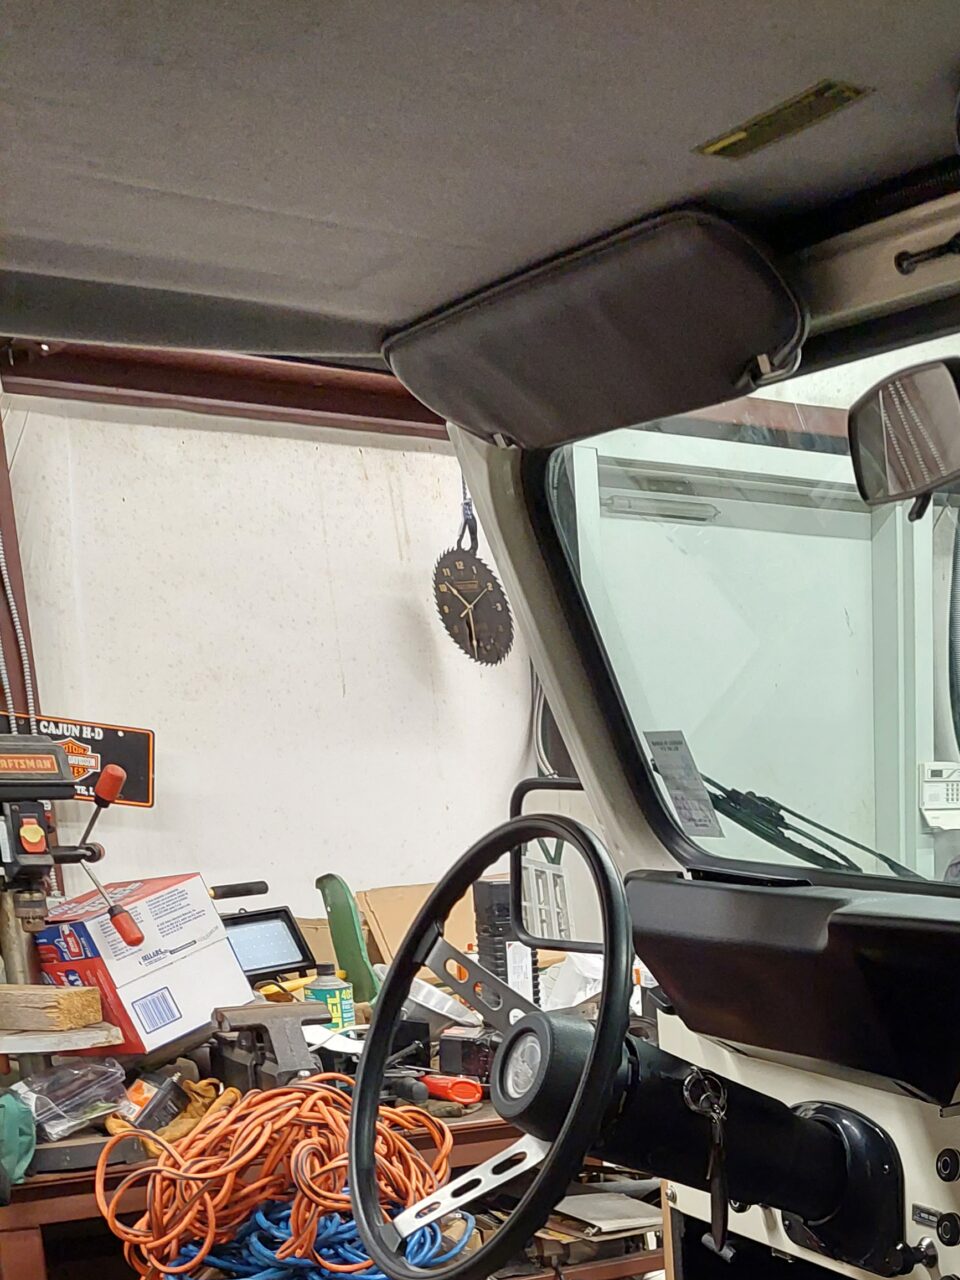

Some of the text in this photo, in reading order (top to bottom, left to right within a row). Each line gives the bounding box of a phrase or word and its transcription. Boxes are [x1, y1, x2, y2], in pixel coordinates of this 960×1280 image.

[455, 561, 464, 570] 12
[442, 567, 451, 577] 11
[40, 720, 104, 740] CAJUN H-D
[0, 758, 52, 769] AFTSMAN
